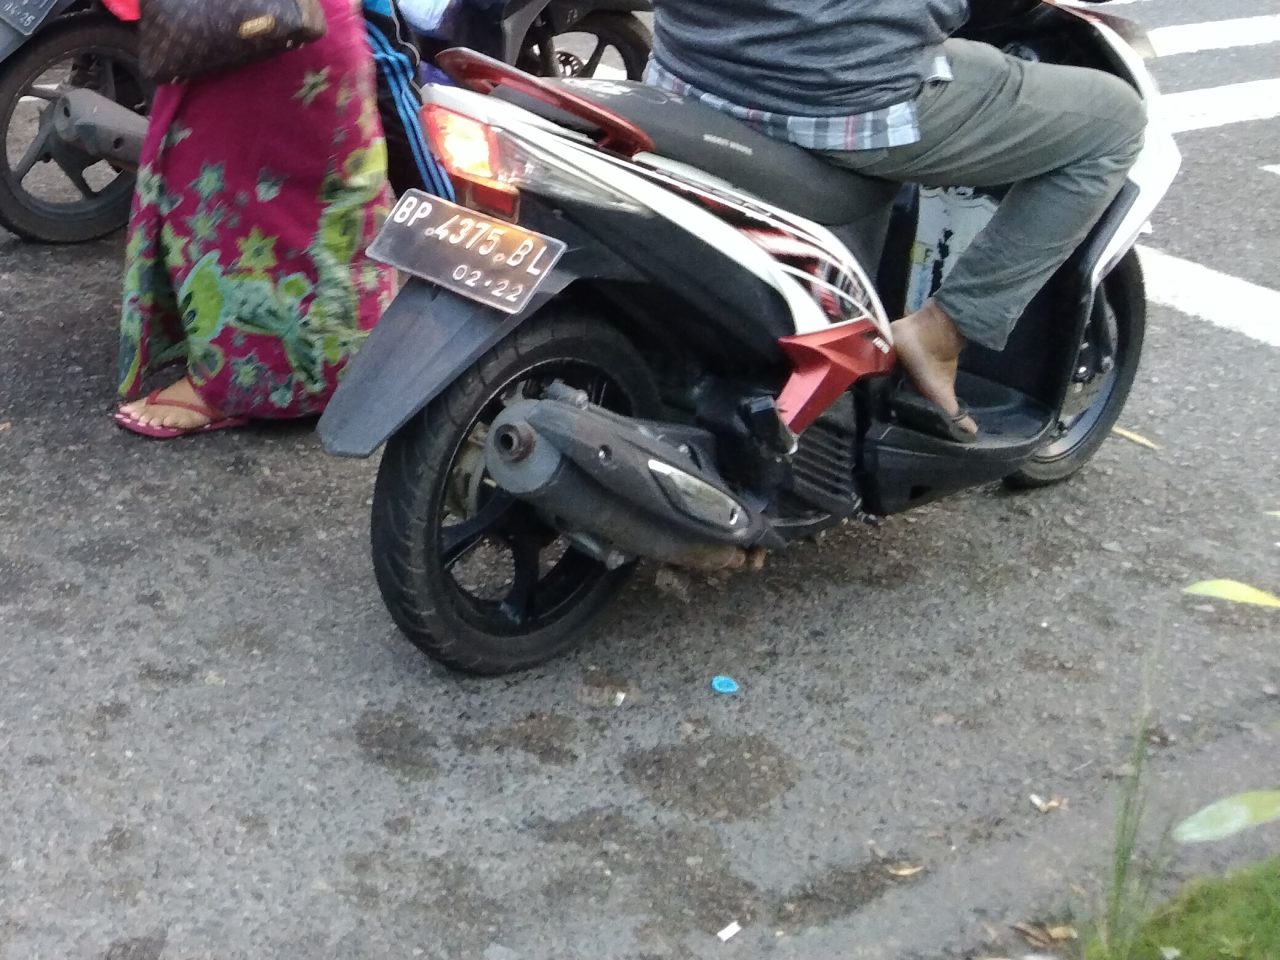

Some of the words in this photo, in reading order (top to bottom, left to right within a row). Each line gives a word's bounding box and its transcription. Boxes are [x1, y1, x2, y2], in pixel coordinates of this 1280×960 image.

[392, 196, 433, 227] BP
[434, 214, 507, 256] 4375
[506, 237, 548, 277] BL
